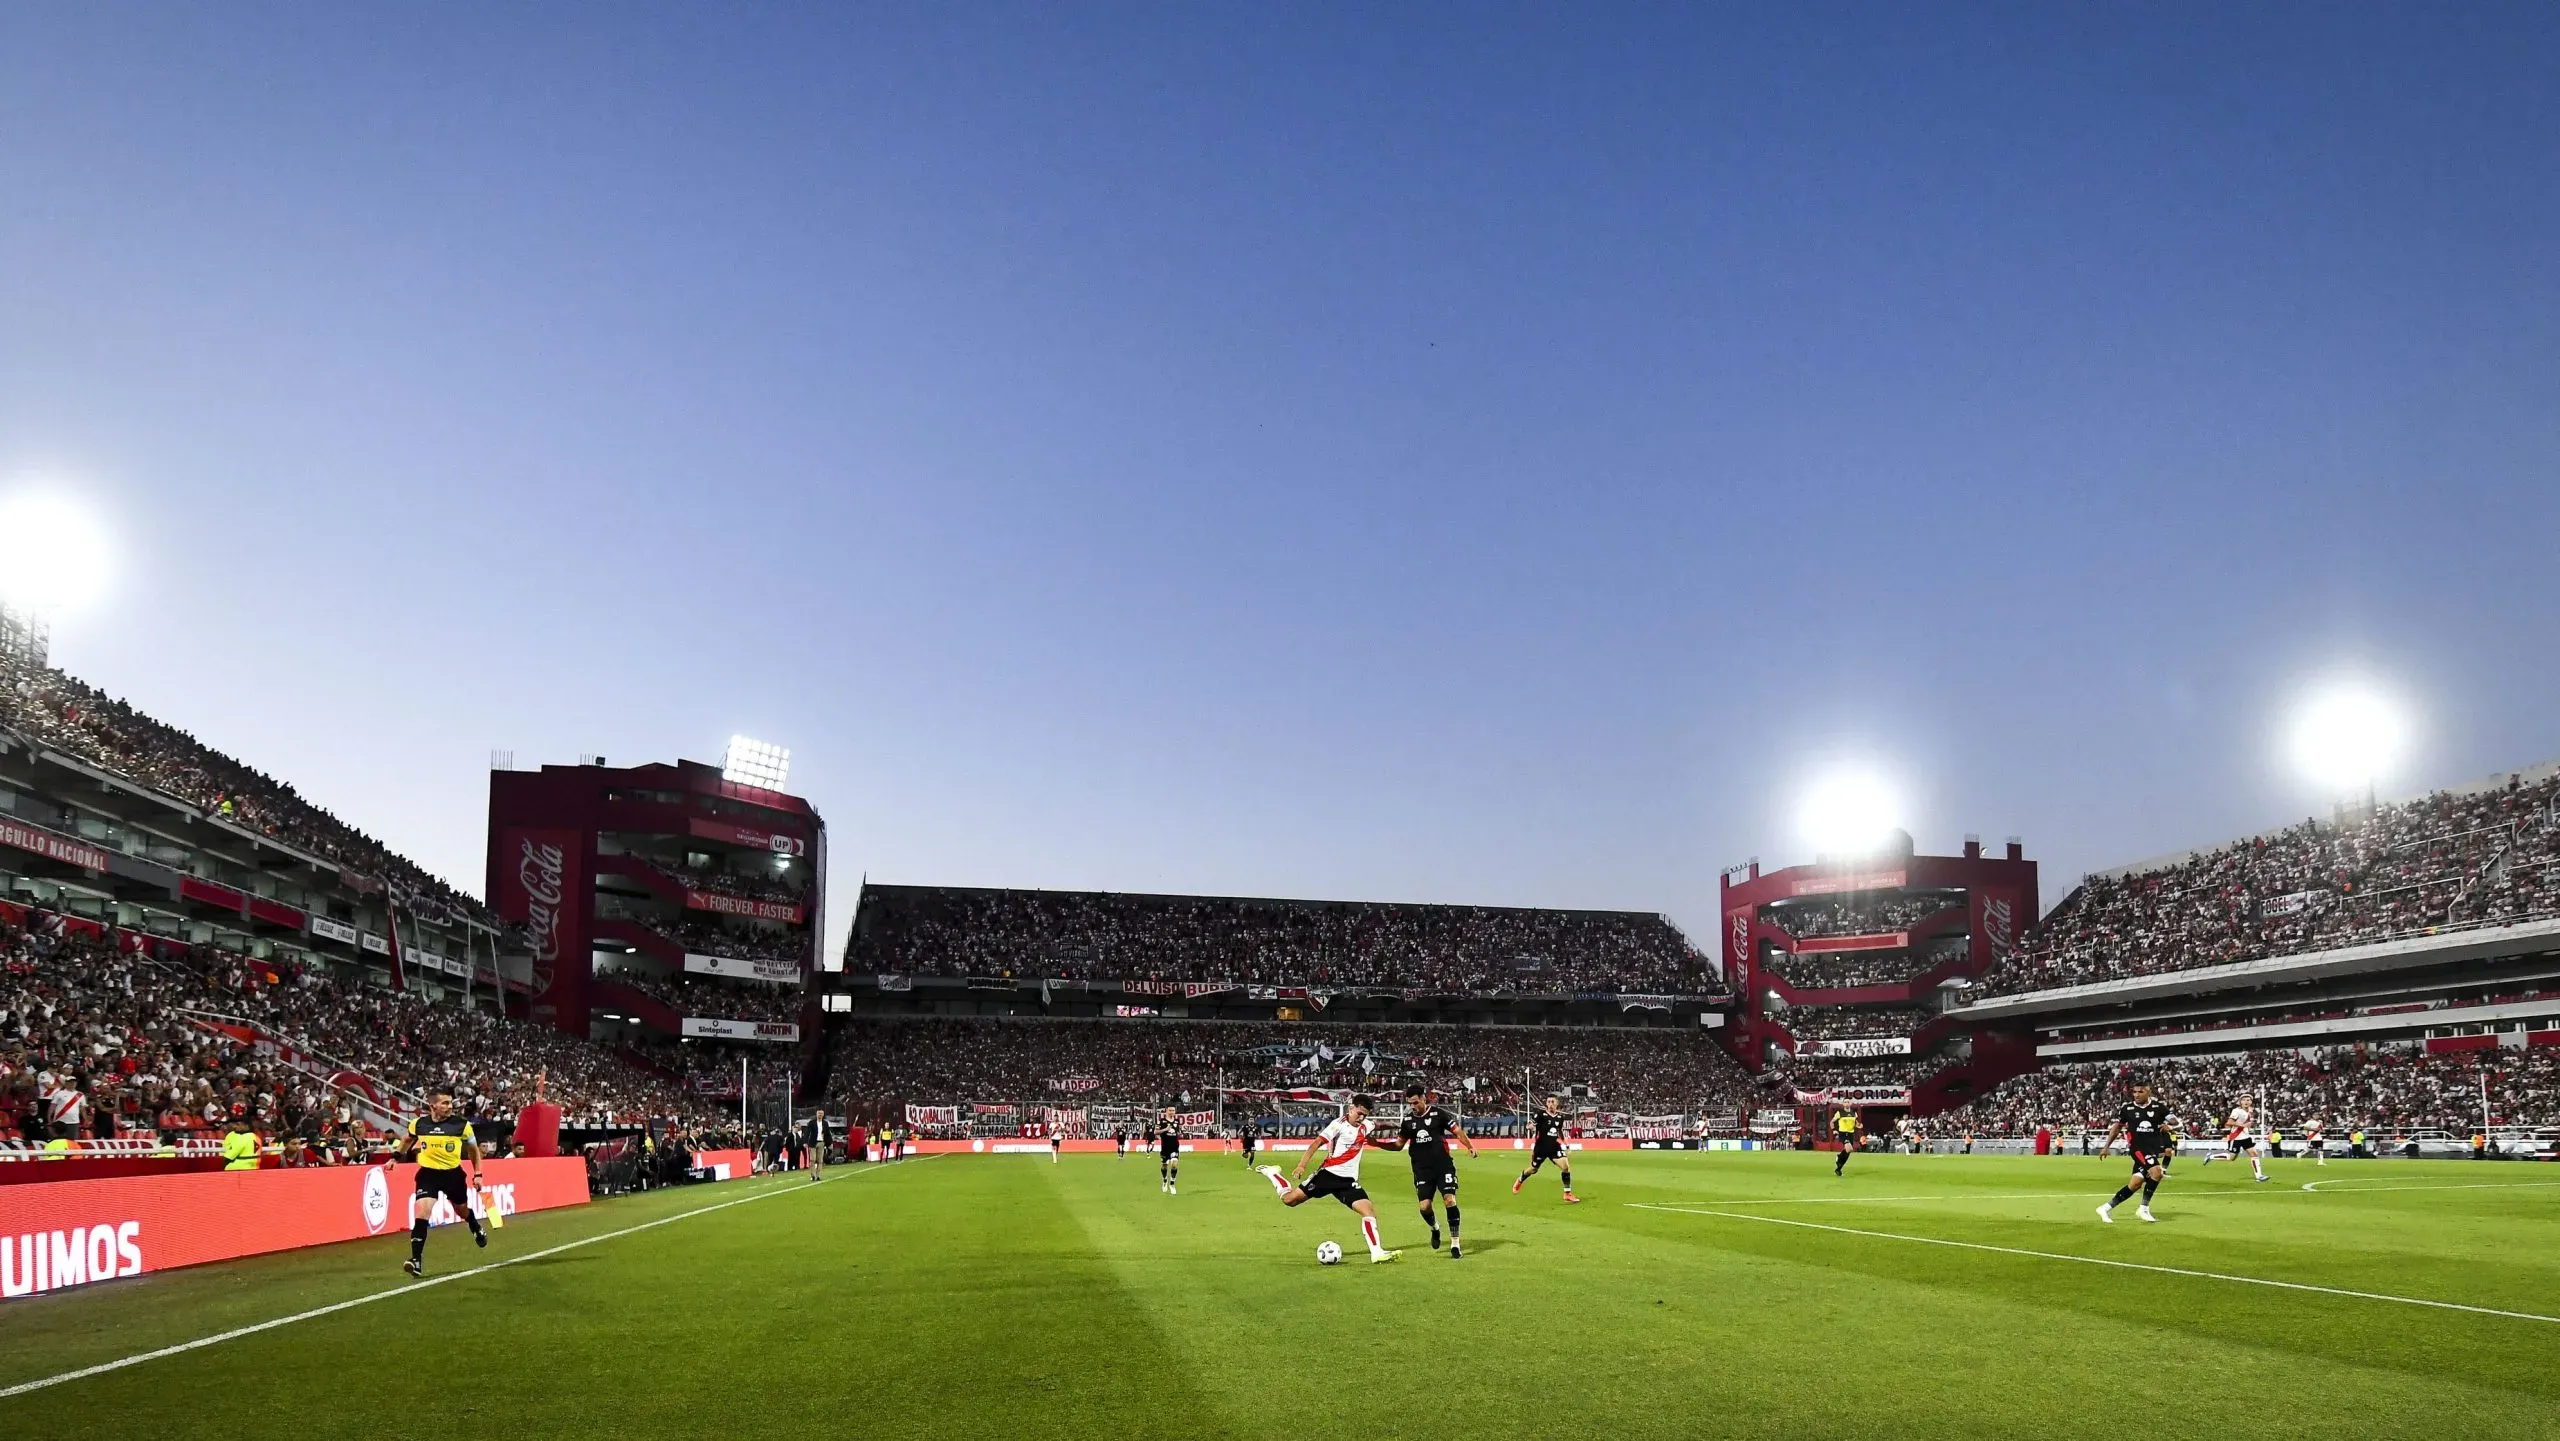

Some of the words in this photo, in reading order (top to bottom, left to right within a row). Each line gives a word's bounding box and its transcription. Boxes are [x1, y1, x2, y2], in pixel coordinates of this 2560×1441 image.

[49, 840, 105, 871] NACIONAL
[709, 895, 756, 916] FOREVER.
[759, 903, 796, 921] FASTER.
[1732, 913, 1749, 994] oca-Cola
[1123, 981, 1147, 993] DEL
[1149, 981, 1180, 995] VISO
[757, 1024, 792, 1035] MARTIN
[1833, 1044, 1905, 1057] ROSARIO
[1844, 1040, 1890, 1049] FILIAL
[1836, 1088, 1902, 1100] FLORIDA
[1444, 1173, 1453, 1184] 5
[0, 1220, 142, 1298] UIMOS
